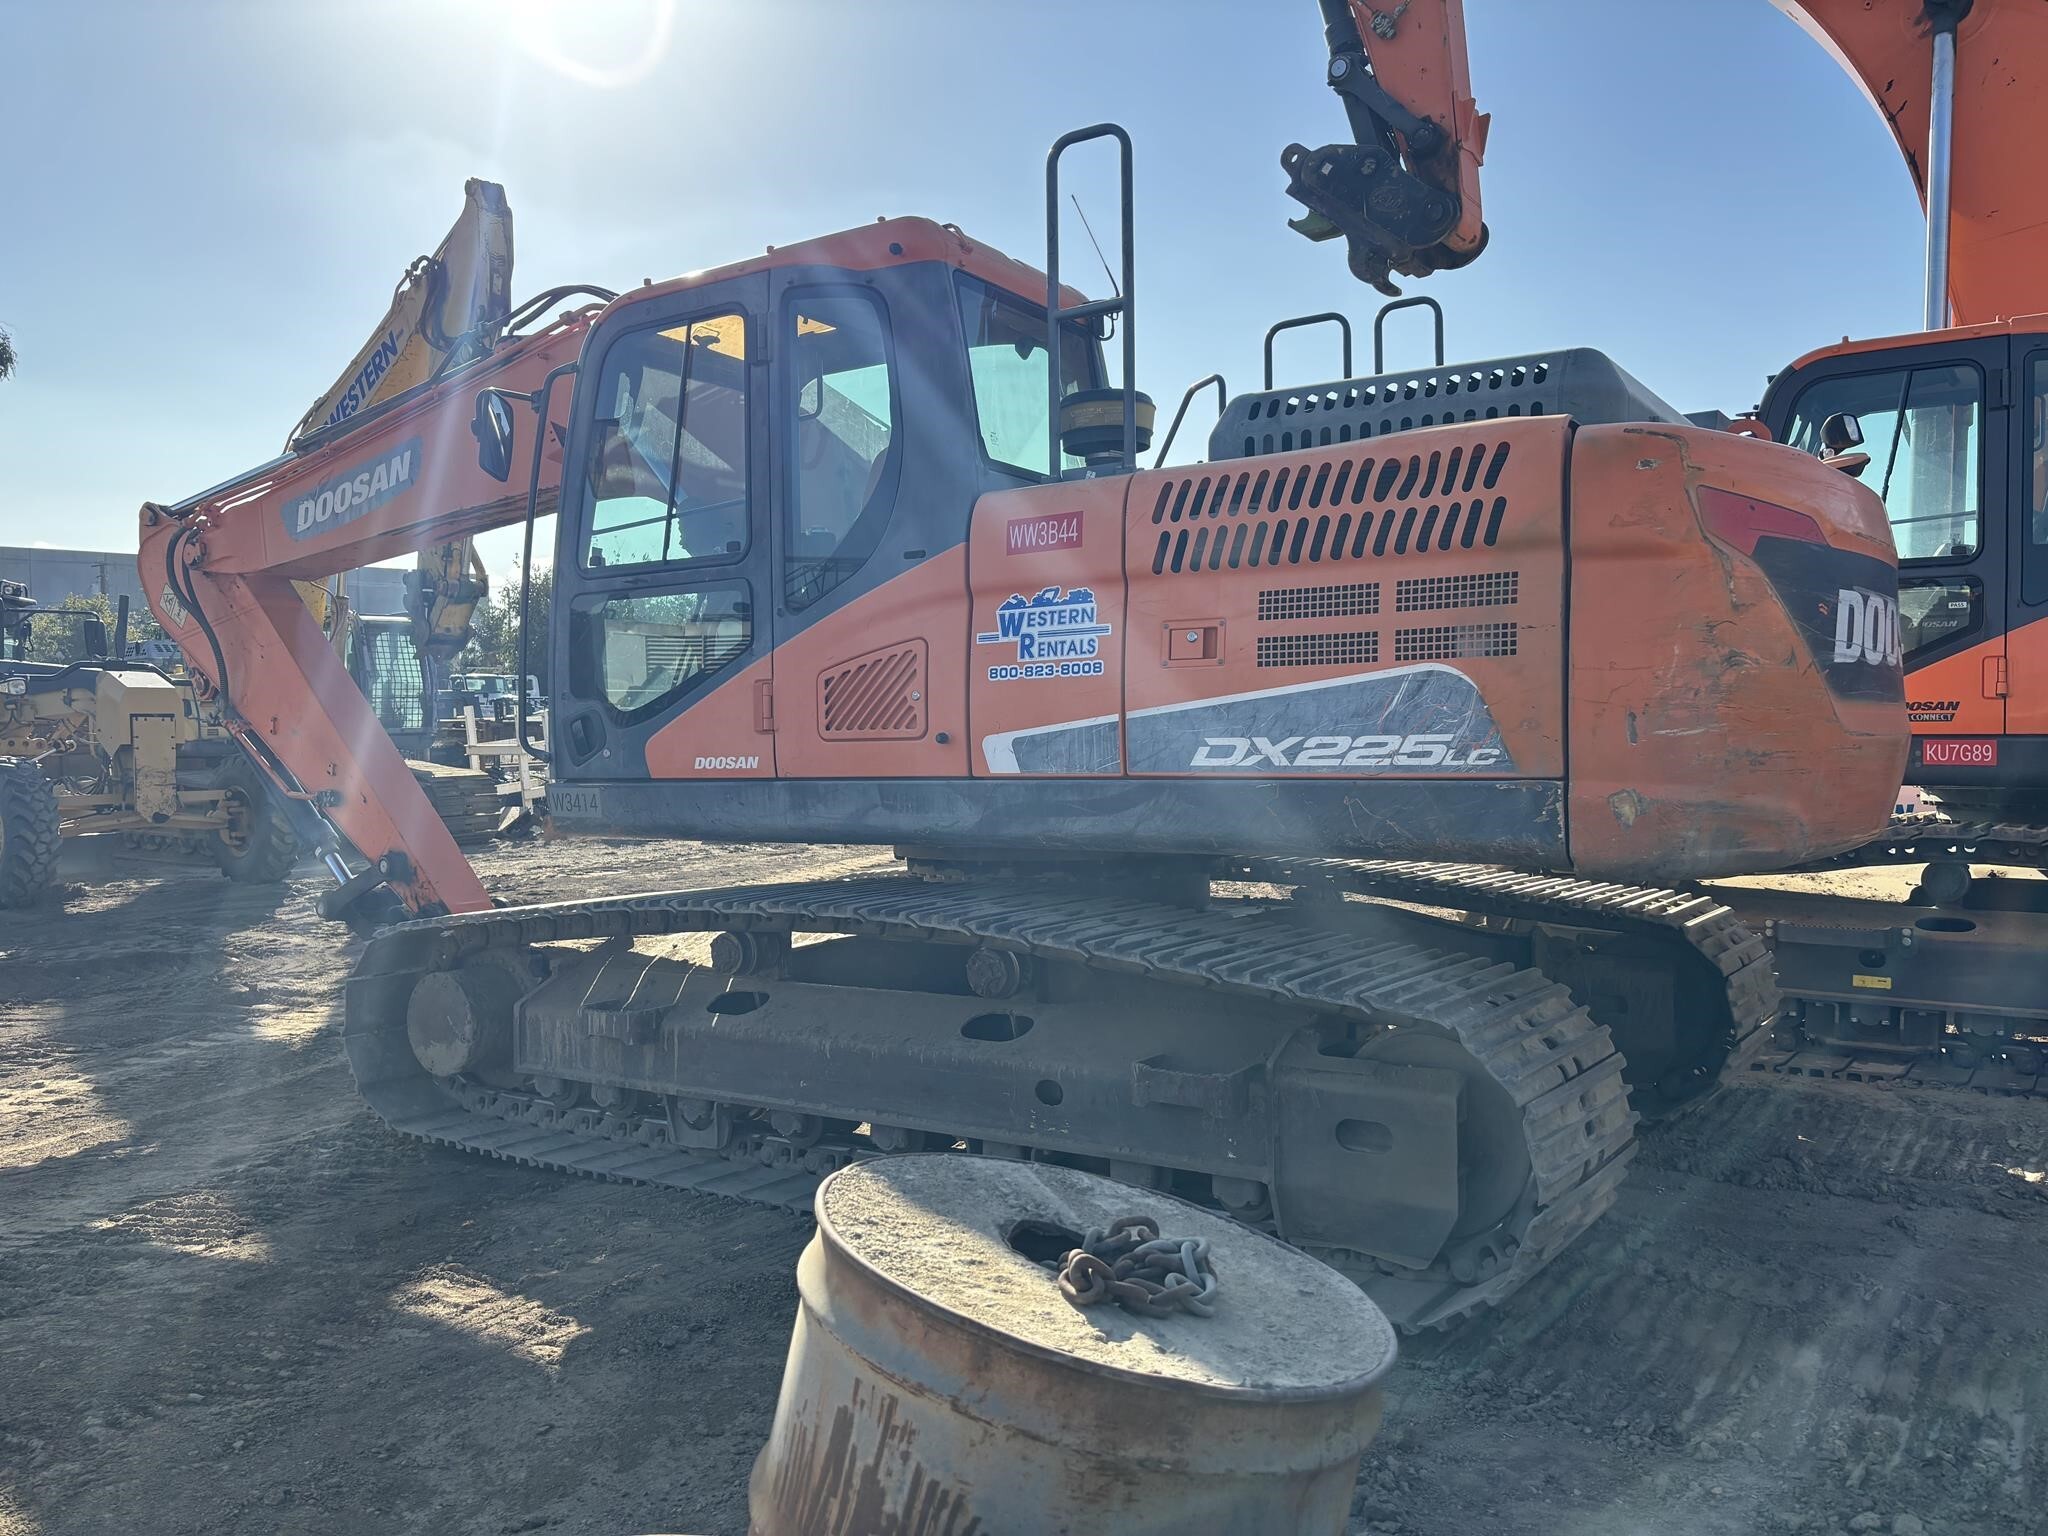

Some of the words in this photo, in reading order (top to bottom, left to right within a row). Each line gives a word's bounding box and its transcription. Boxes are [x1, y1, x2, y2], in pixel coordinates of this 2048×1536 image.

[296, 450, 411, 533] DOOSAN
[1010, 518, 1078, 549] WW3B44
[999, 606, 1096, 638] WESTERN
[1834, 589, 1904, 666] DOO
[1019, 634, 1097, 660] RENTALS
[989, 662, 1102, 678] 800-823-8008
[1910, 713, 1952, 721] CONNECT
[694, 756, 759, 770] DOOSAN
[1926, 743, 1992, 762] KU7G89
